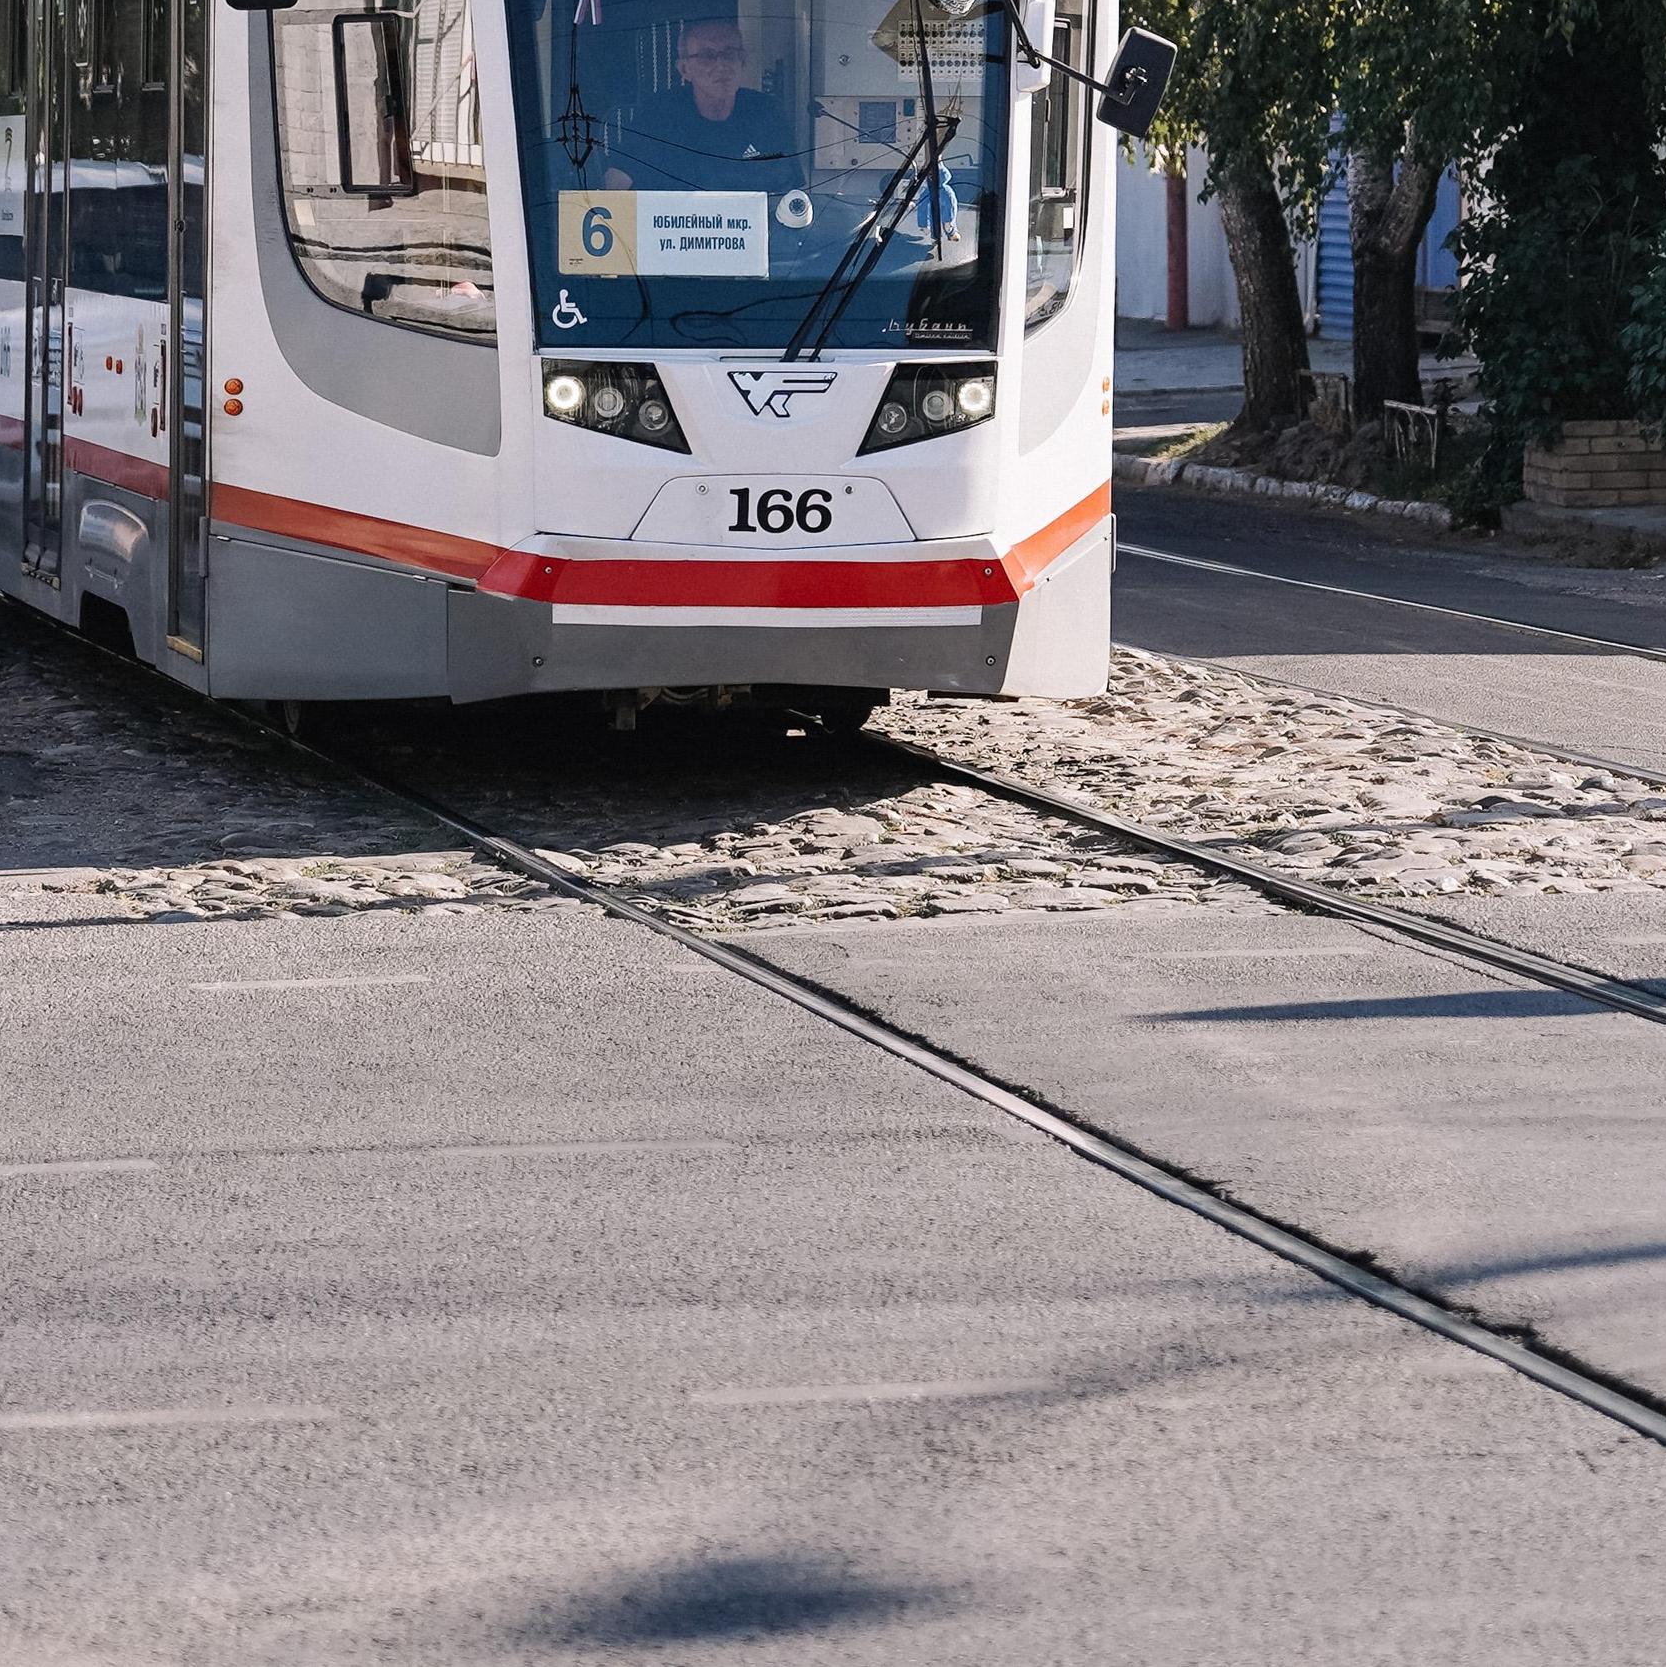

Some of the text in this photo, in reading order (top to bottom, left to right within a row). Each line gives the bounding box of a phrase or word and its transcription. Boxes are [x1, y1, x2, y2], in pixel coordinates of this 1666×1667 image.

[582, 206, 614, 258] 6
[653, 214, 752, 232] ЮБИЛЕЙНЫЙ мкр.
[659, 236, 746, 252] ул. ДИМИТРОВА
[728, 487, 833, 534] 166
